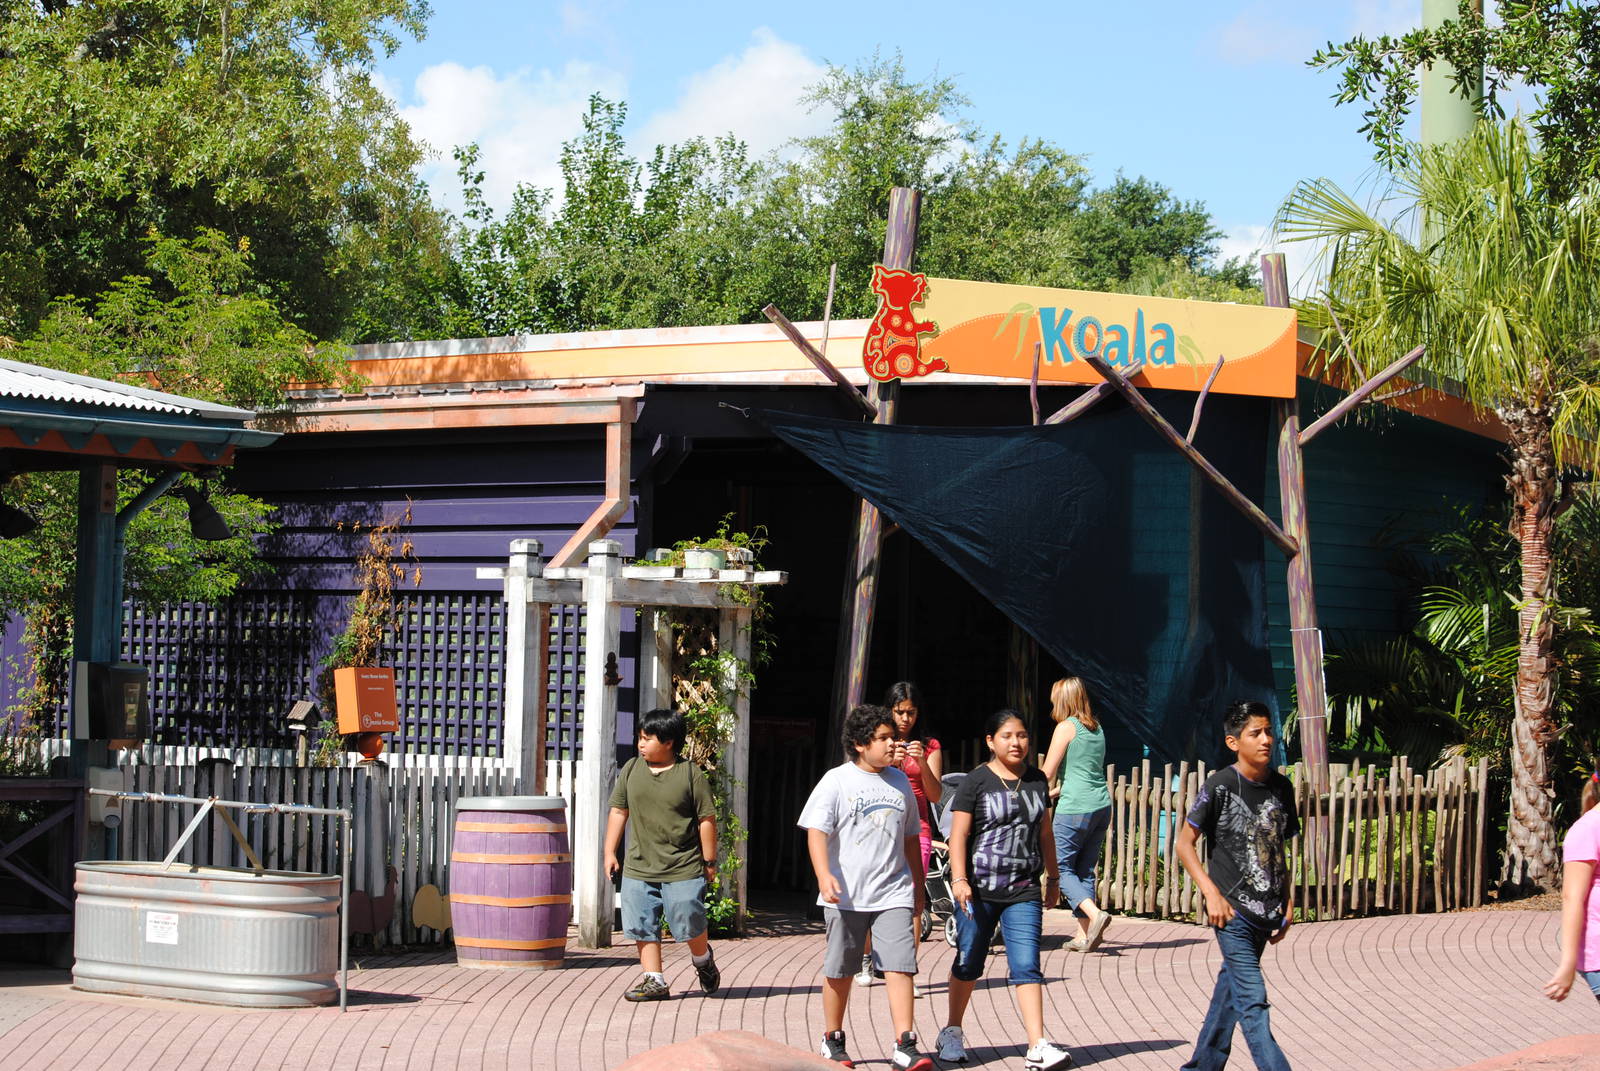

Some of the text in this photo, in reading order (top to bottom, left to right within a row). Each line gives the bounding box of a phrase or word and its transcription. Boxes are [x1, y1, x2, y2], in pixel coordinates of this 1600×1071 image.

[1038, 307, 1176, 367] Koala
[850, 796, 902, 818] Baseball
[982, 789, 1046, 823] NEW
